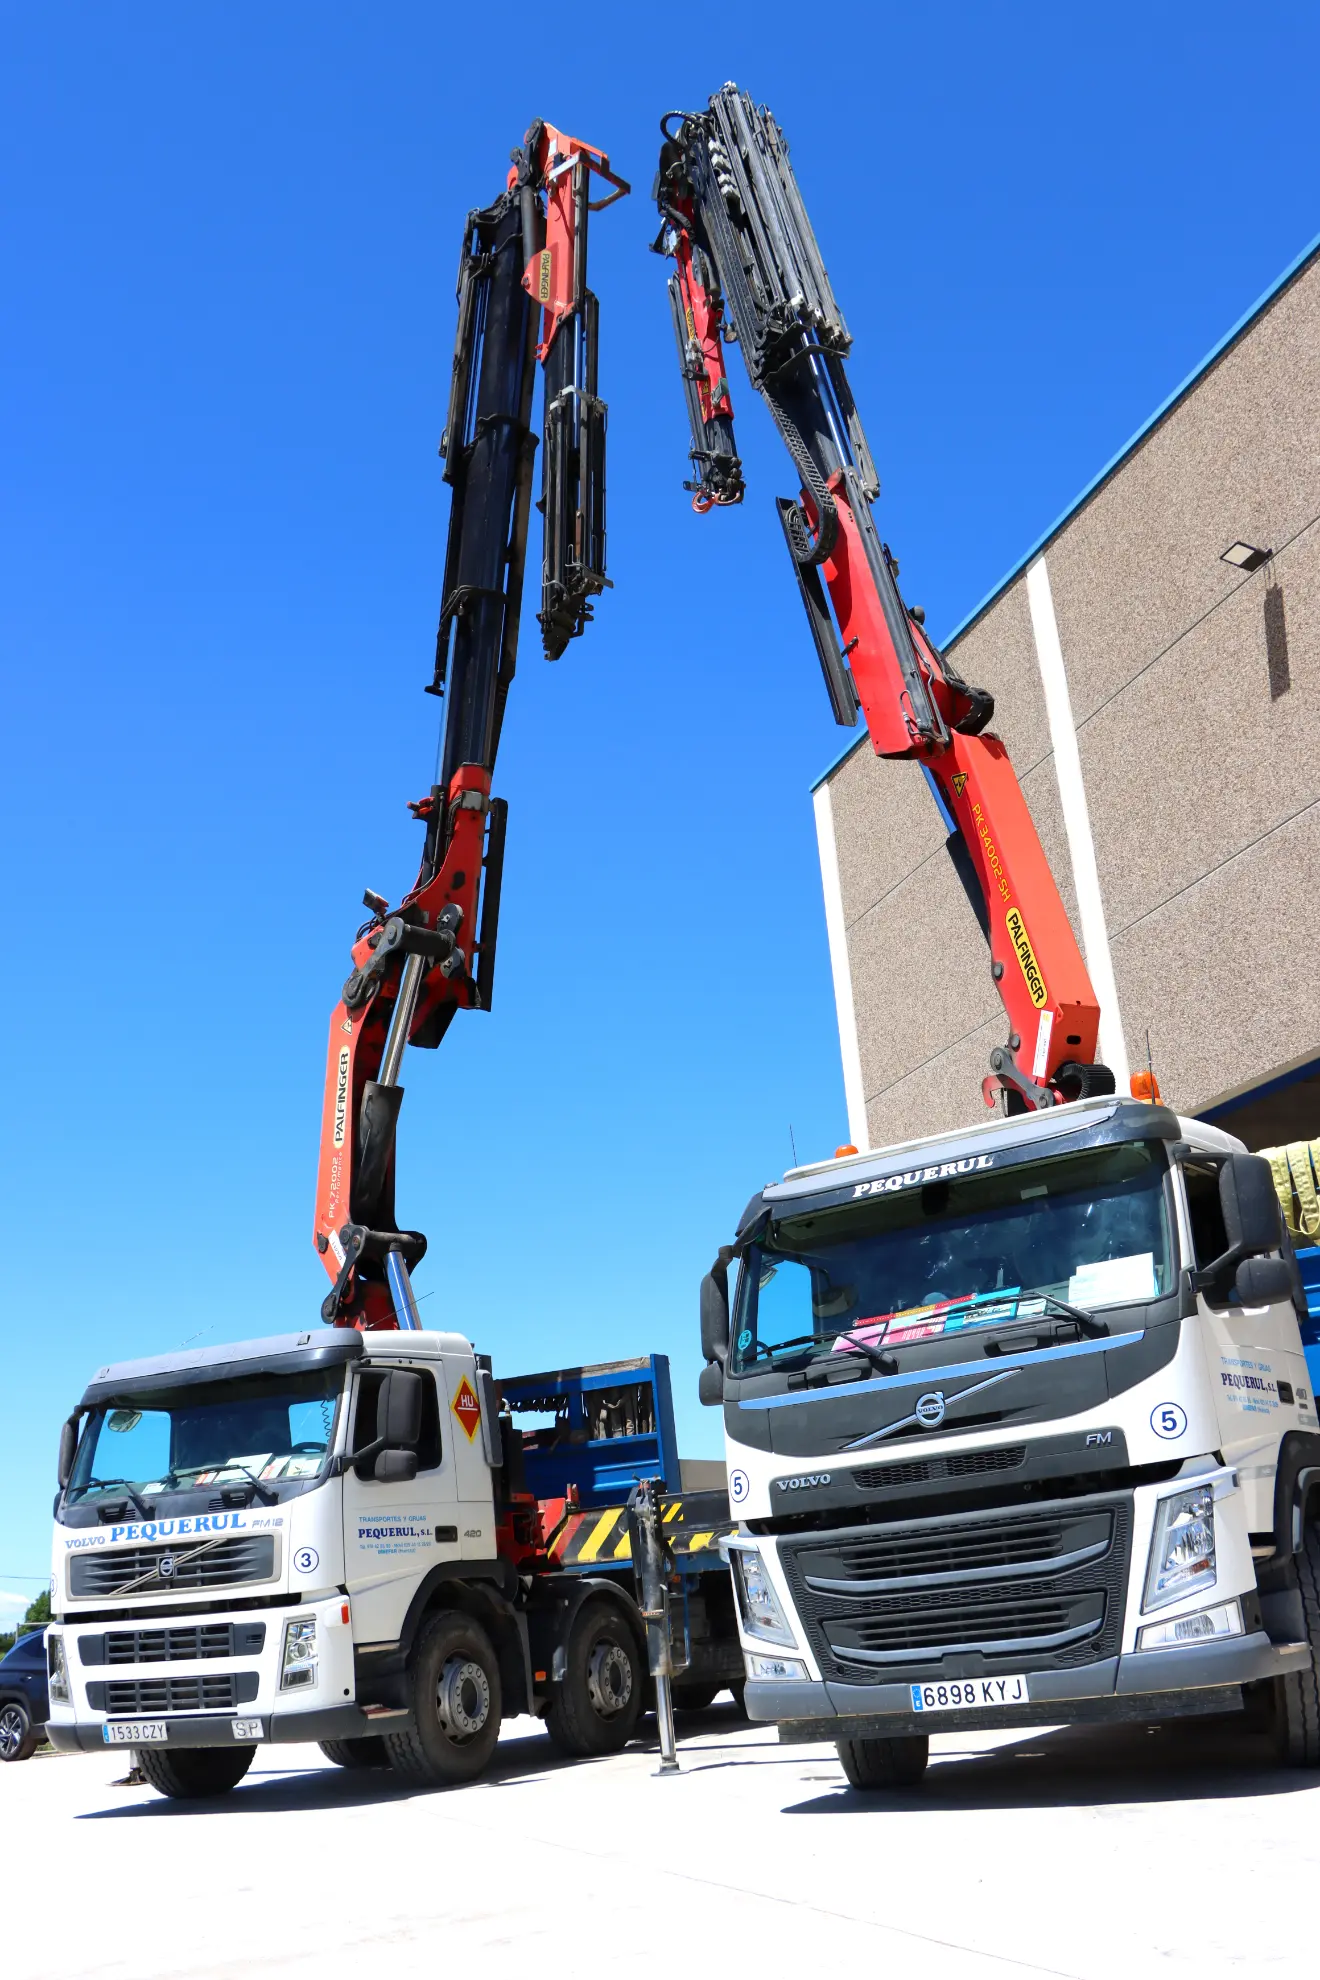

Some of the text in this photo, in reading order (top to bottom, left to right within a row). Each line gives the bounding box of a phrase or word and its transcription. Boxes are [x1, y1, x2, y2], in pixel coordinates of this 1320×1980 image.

[541, 253, 550, 299] PALFINGER
[972, 803, 984, 826] PK
[1008, 912, 1045, 1004] PALFINGER
[335, 1052, 349, 1142] PALFINGER
[852, 1154, 995, 1198] PEQUERUL
[328, 1157, 339, 1218] PK 72002
[461, 1393, 474, 1408] HU
[918, 1404, 944, 1414] VOLVO
[1161, 1410, 1178, 1432] 5
[1086, 1431, 1112, 1446] FM
[733, 1476, 743, 1496] 5
[777, 1473, 832, 1491] VOLVO
[110, 1513, 247, 1542] PEQUERUL
[251, 1517, 284, 1529] FM12
[359, 1515, 402, 1523] TRANSPORTES
[65, 1535, 106, 1549] VOLVO
[358, 1526, 420, 1540] PEQUERUL,
[463, 1529, 482, 1538] 420
[300, 1552, 312, 1568] 3
[923, 1683, 976, 1707] 6898
[981, 1678, 1022, 1703] KYJ
[111, 1723, 164, 1741] 1533 CZY
[235, 1721, 259, 1737] SP
